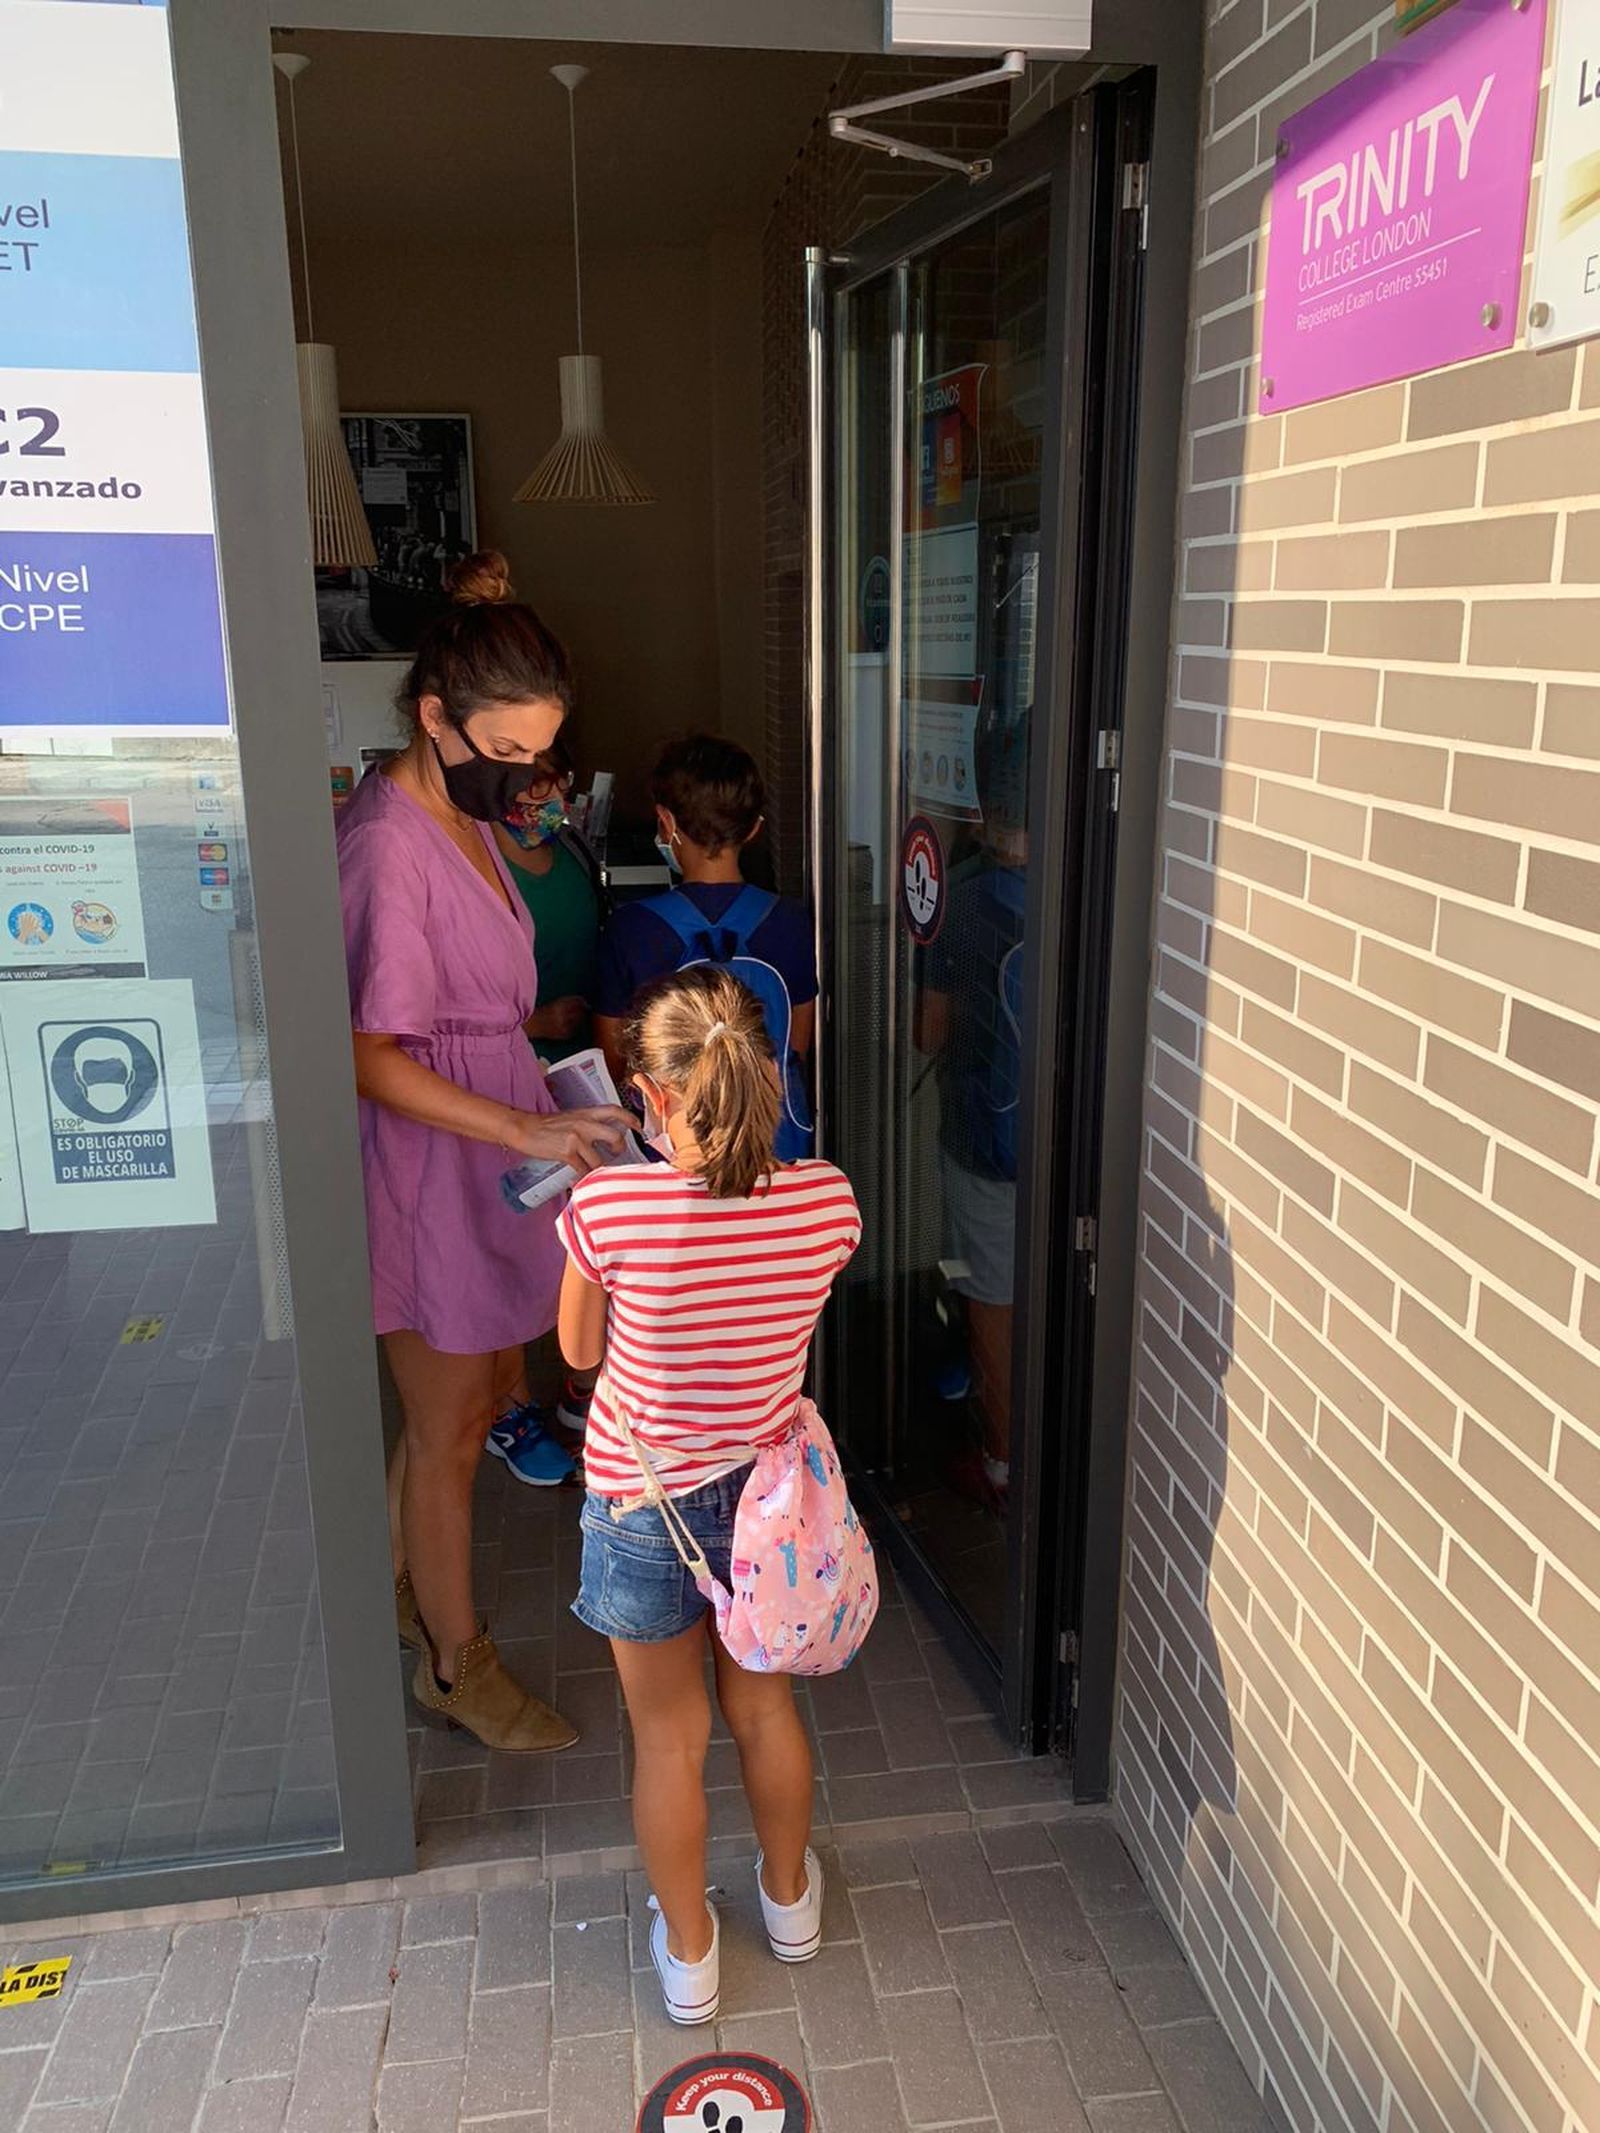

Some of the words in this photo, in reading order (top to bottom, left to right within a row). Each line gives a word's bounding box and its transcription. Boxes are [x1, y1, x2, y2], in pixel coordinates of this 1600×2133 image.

[1579, 59, 1600, 107] L
[1297, 73, 1495, 255] TRINITY
[1299, 240, 1360, 292] COLLEGE
[1363, 208, 1432, 264] LONDON
[1584, 254, 1600, 293] E
[1297, 296, 1344, 331] Registered
[1346, 289, 1374, 313] Exam
[1376, 275, 1412, 301] Centre
[1413, 257, 1447, 287] 55451
[0, 407, 66, 456] 2
[0, 564, 89, 593] Nivel
[0, 604, 85, 632] CPE
[0, 846, 31, 855] contra
[33, 845, 43, 855] el
[45, 844, 95, 854] COVID-19
[5, 865, 41, 875] against
[43, 863, 76, 873] COVID
[57, 1137, 72, 1151] ES
[75, 1134, 167, 1150] OBLIGATORIO
[88, 1150, 103, 1164] EL
[106, 1149, 135, 1163] USO
[62, 1166, 79, 1179] DE
[82, 1162, 168, 1178] MASCARILLA
[675, 2083, 700, 2112] Keep
[700, 2072, 730, 2087] your
[732, 2072, 773, 2107] distance
